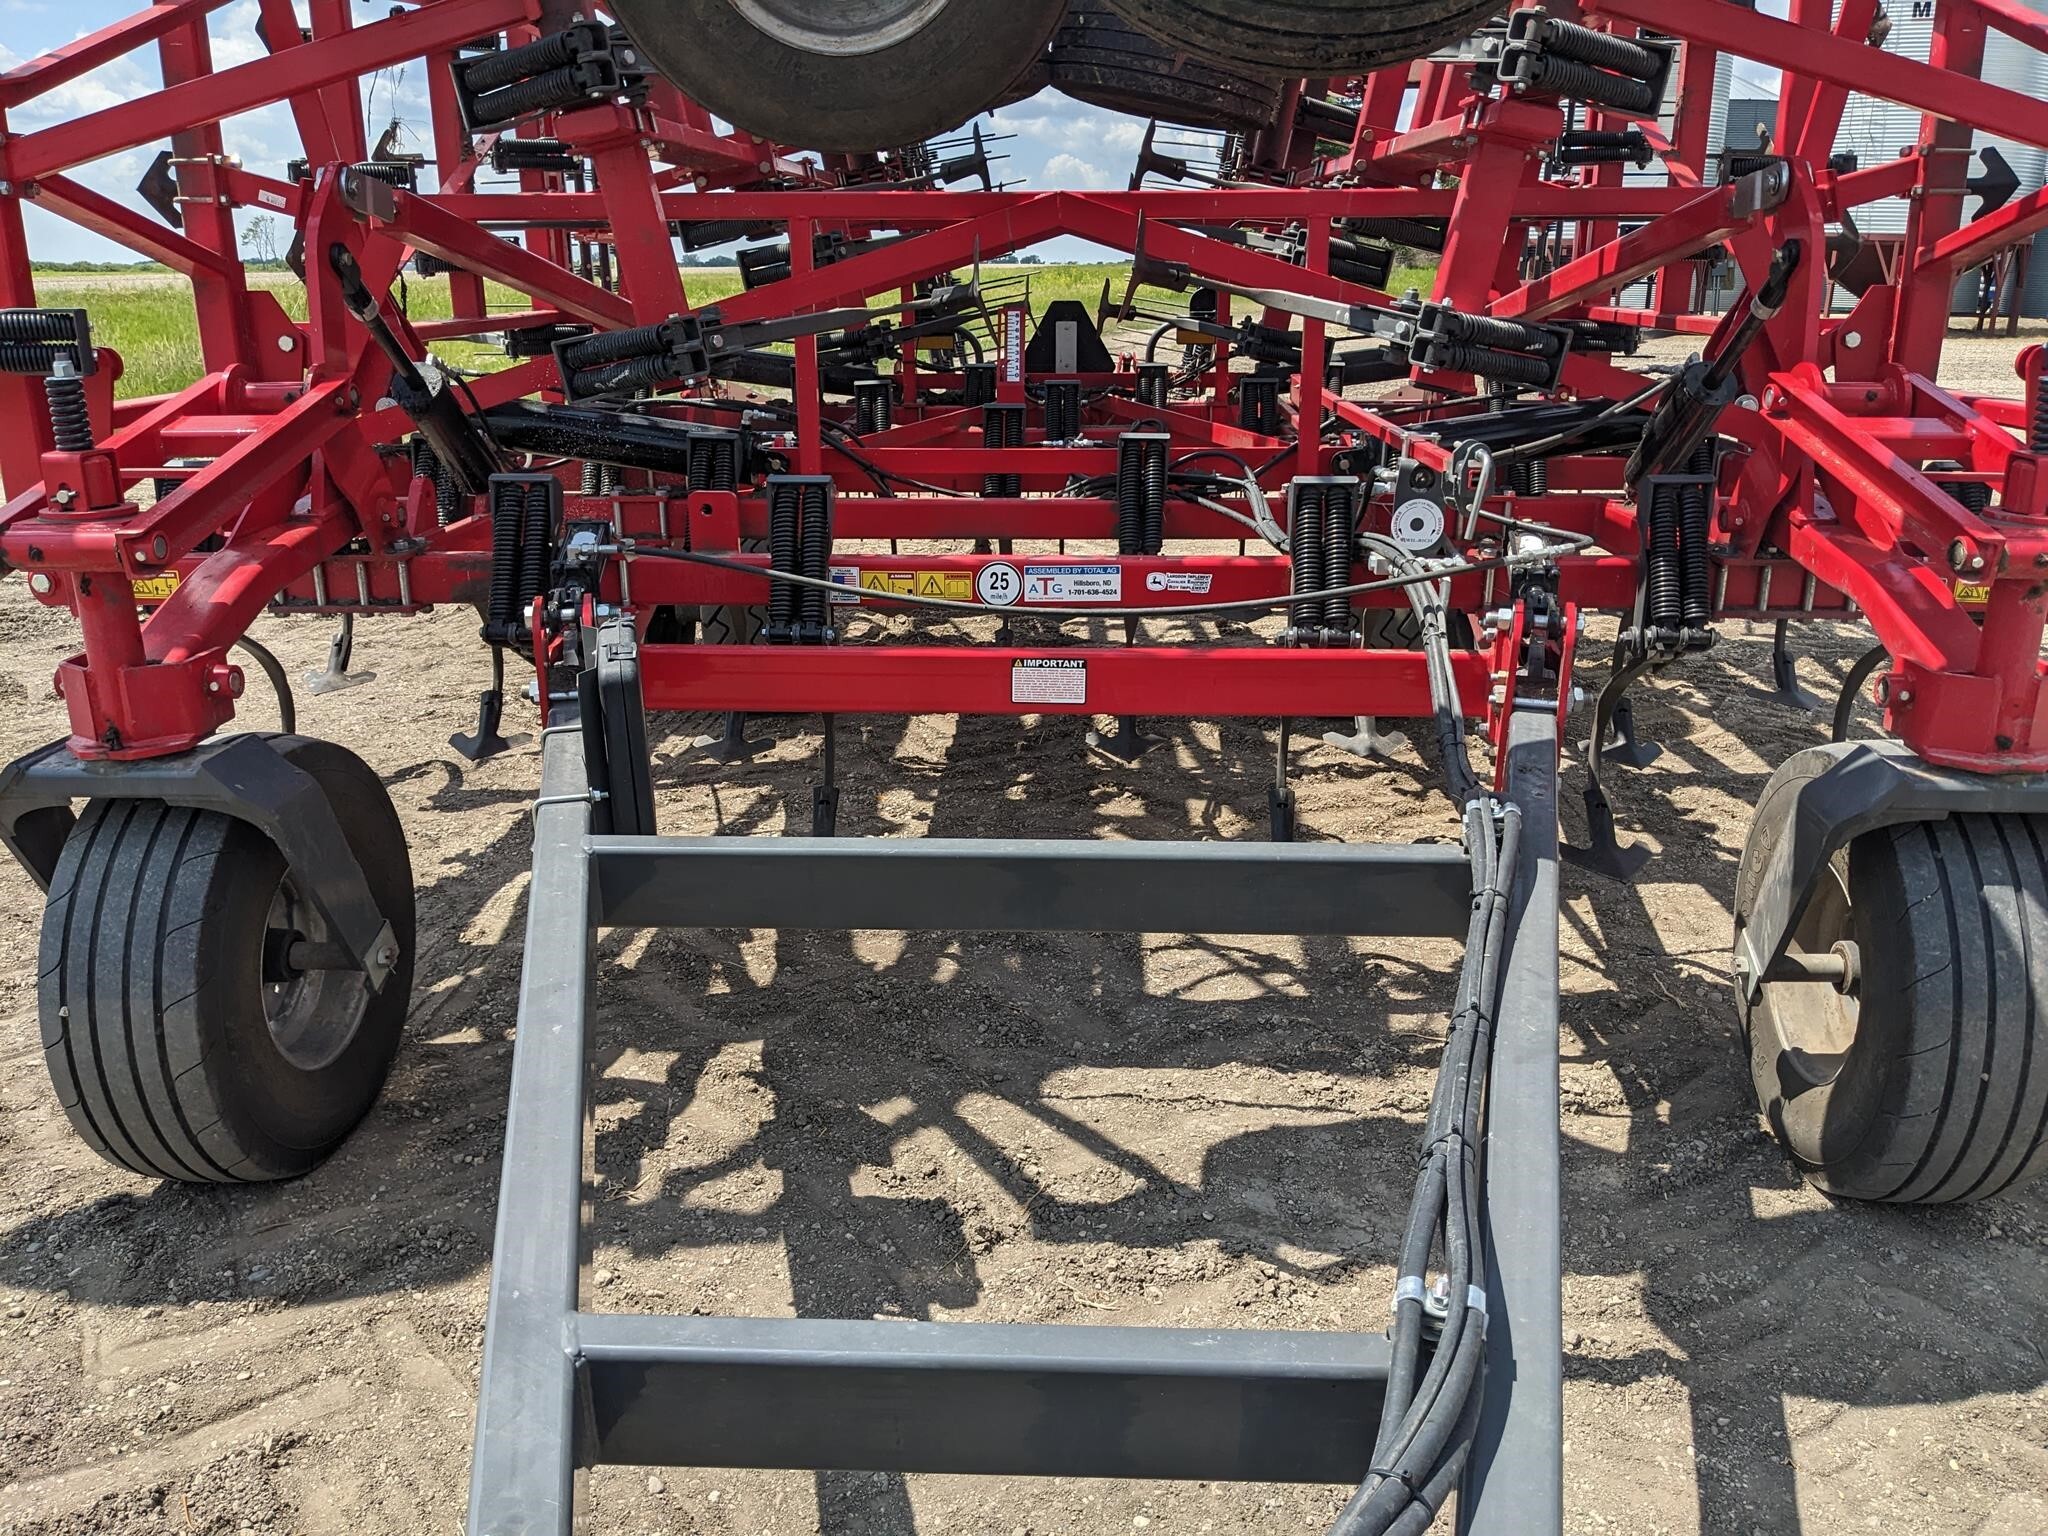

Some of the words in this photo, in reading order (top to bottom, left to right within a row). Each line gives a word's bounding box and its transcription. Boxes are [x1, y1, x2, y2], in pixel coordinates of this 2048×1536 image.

[1912, 1, 1932, 18] M
[989, 571, 1010, 590] 25
[1073, 579, 1101, 587] Hillsboro,
[1023, 659, 1085, 668] IMPORTANT
